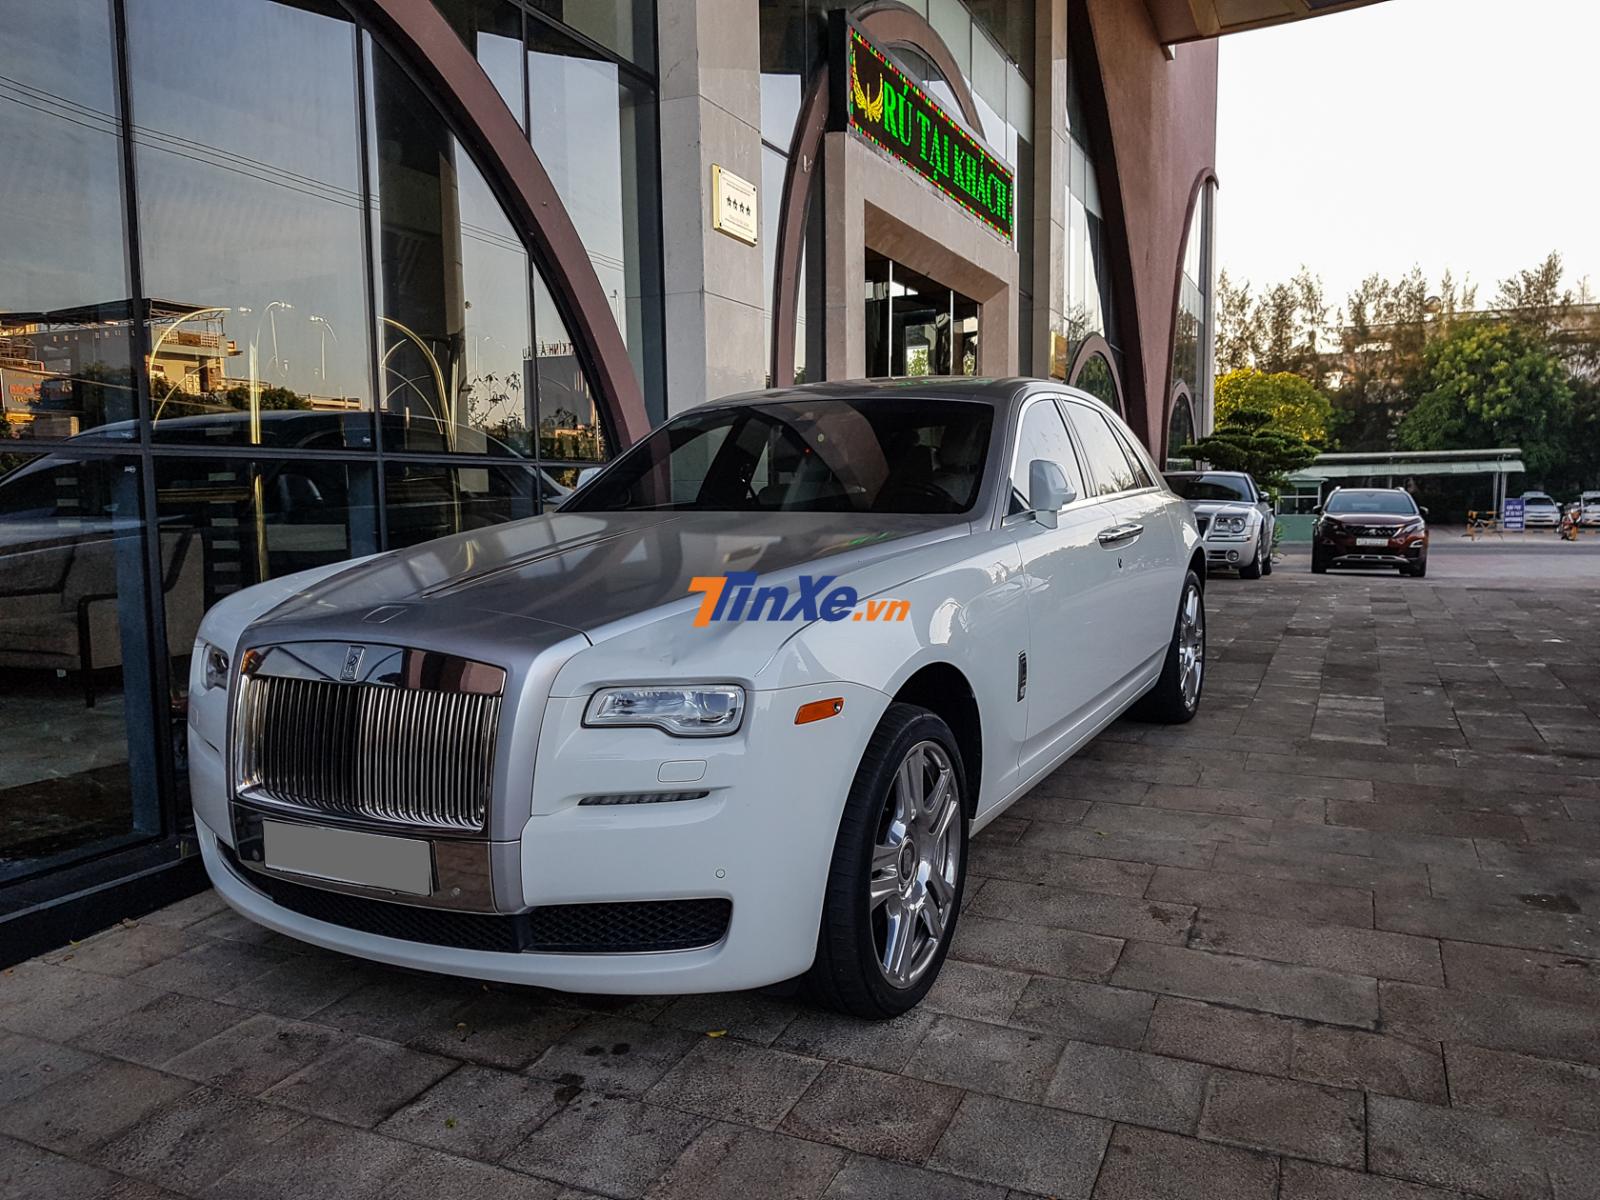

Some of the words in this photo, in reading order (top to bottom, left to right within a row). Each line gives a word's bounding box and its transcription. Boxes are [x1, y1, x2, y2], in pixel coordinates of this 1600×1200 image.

[883, 80, 914, 147] RÚ
[916, 108, 950, 182] TẠI
[953, 143, 1007, 221] KHÁCH
